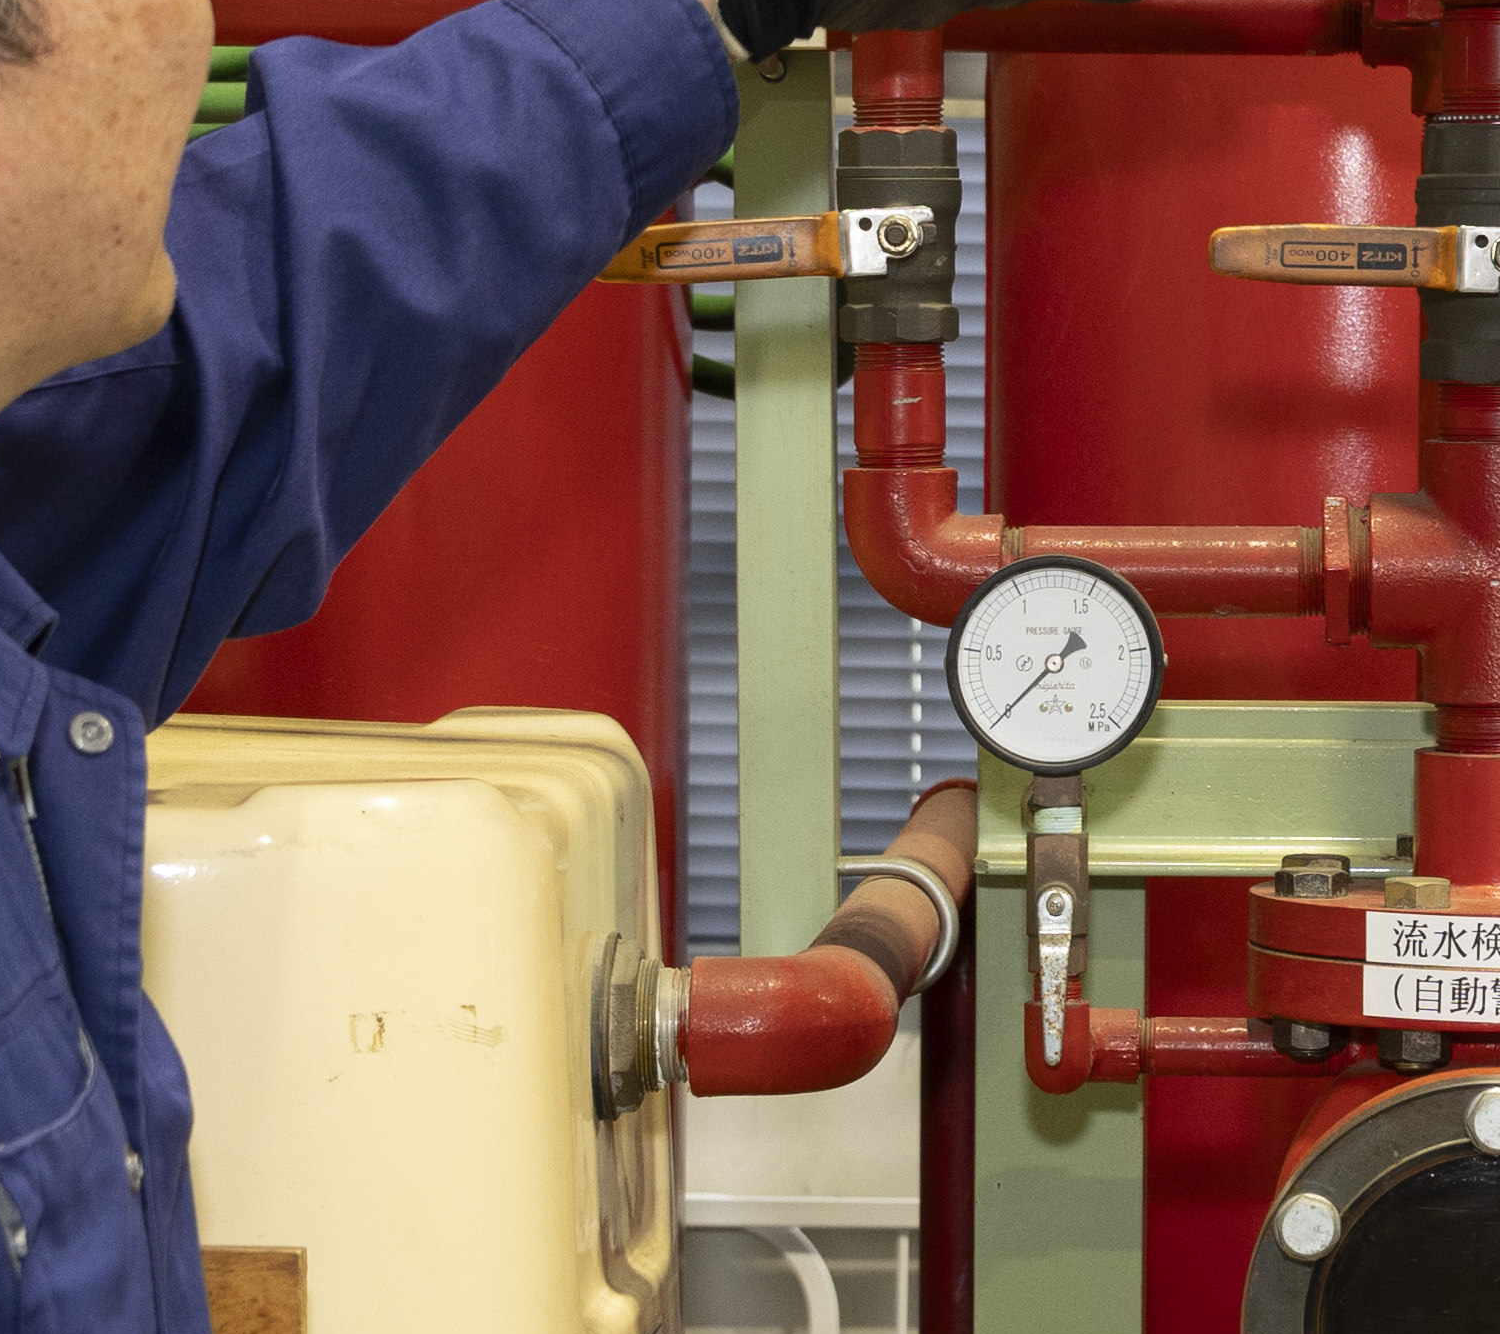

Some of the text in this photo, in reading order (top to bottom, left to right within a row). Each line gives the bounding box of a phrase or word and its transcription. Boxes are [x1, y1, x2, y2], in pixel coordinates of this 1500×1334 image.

[1361, 250, 1403, 263] KITZ
[1021, 598, 1027, 615] 1
[1073, 598, 1089, 615] 1.5
[1025, 626, 1084, 636] PRESSURE GAUGE
[985, 644, 1003, 662] 0.5
[1117, 644, 1126, 661] 2
[1089, 702, 1107, 719] 2.5
[1087, 721, 1111, 733] MPa
